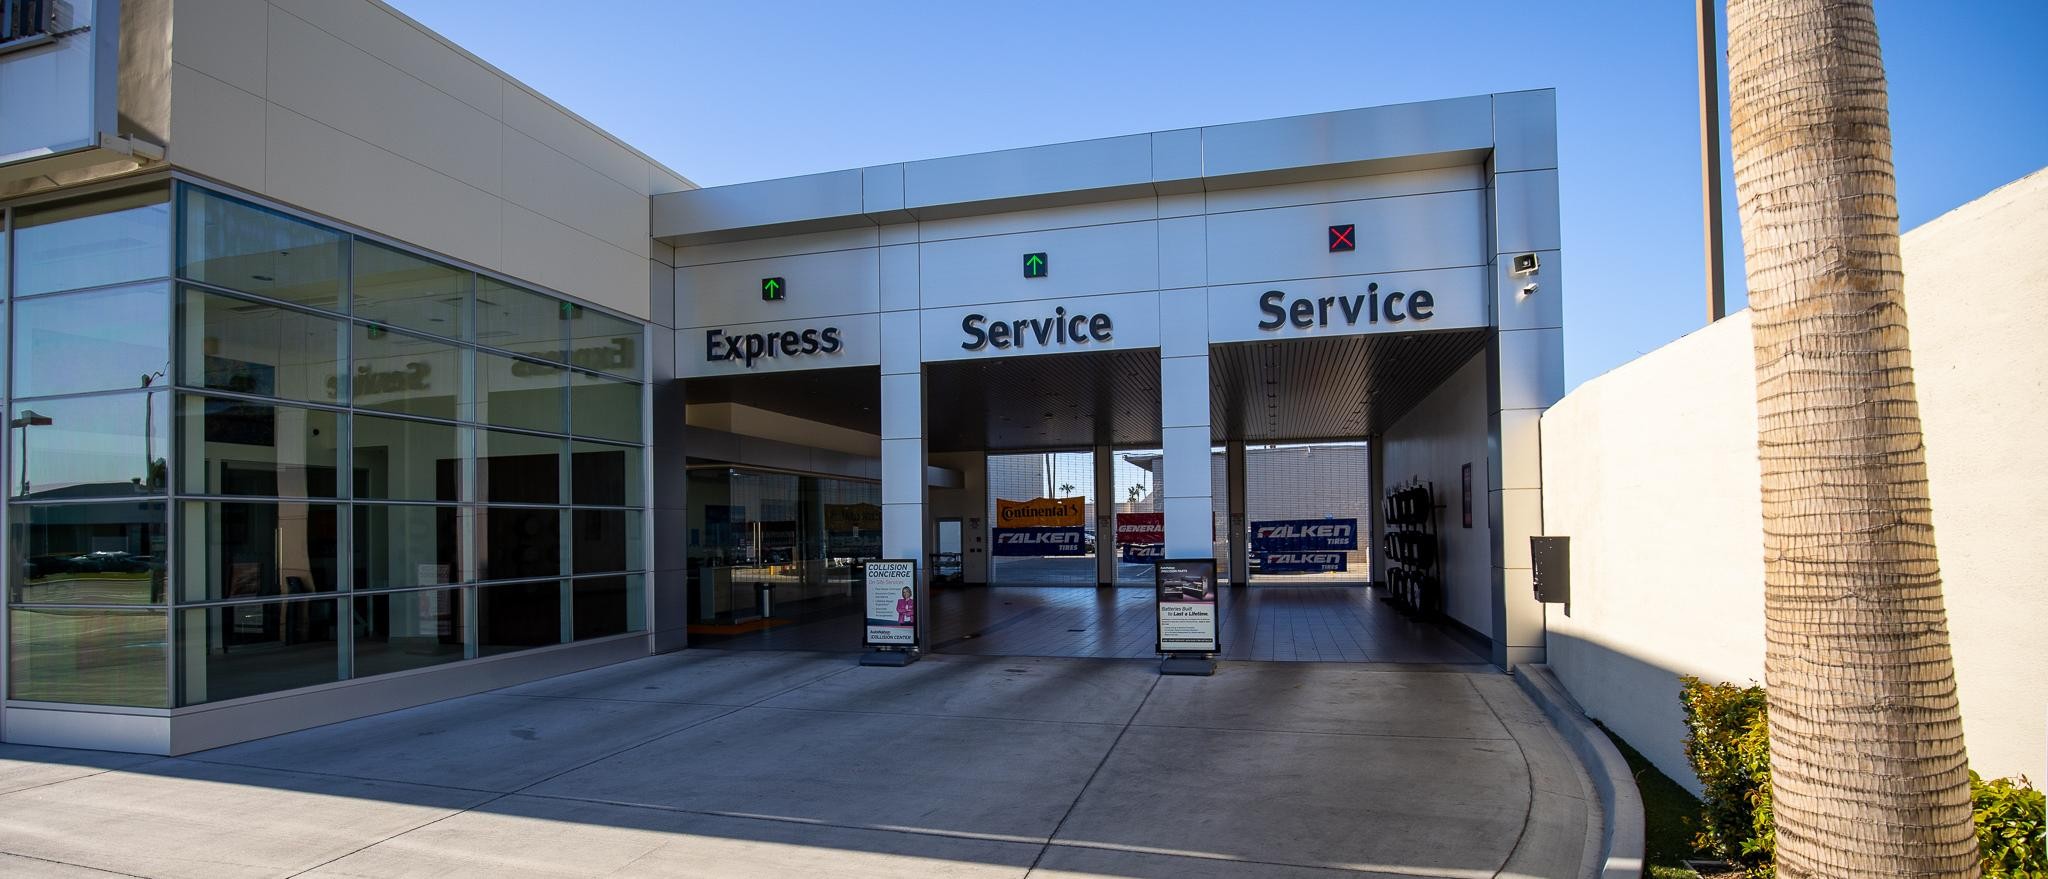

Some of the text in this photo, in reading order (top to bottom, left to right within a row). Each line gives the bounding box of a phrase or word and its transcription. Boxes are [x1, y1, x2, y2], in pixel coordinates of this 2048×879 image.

[1258, 282, 1435, 331] Service
[961, 306, 1113, 351] Service
[705, 326, 842, 368] Express
[1002, 503, 1068, 522] Continental
[997, 532, 1080, 544] FALKEN
[1256, 524, 1352, 538] FALKEN
[1267, 553, 1341, 564] FALKEN
